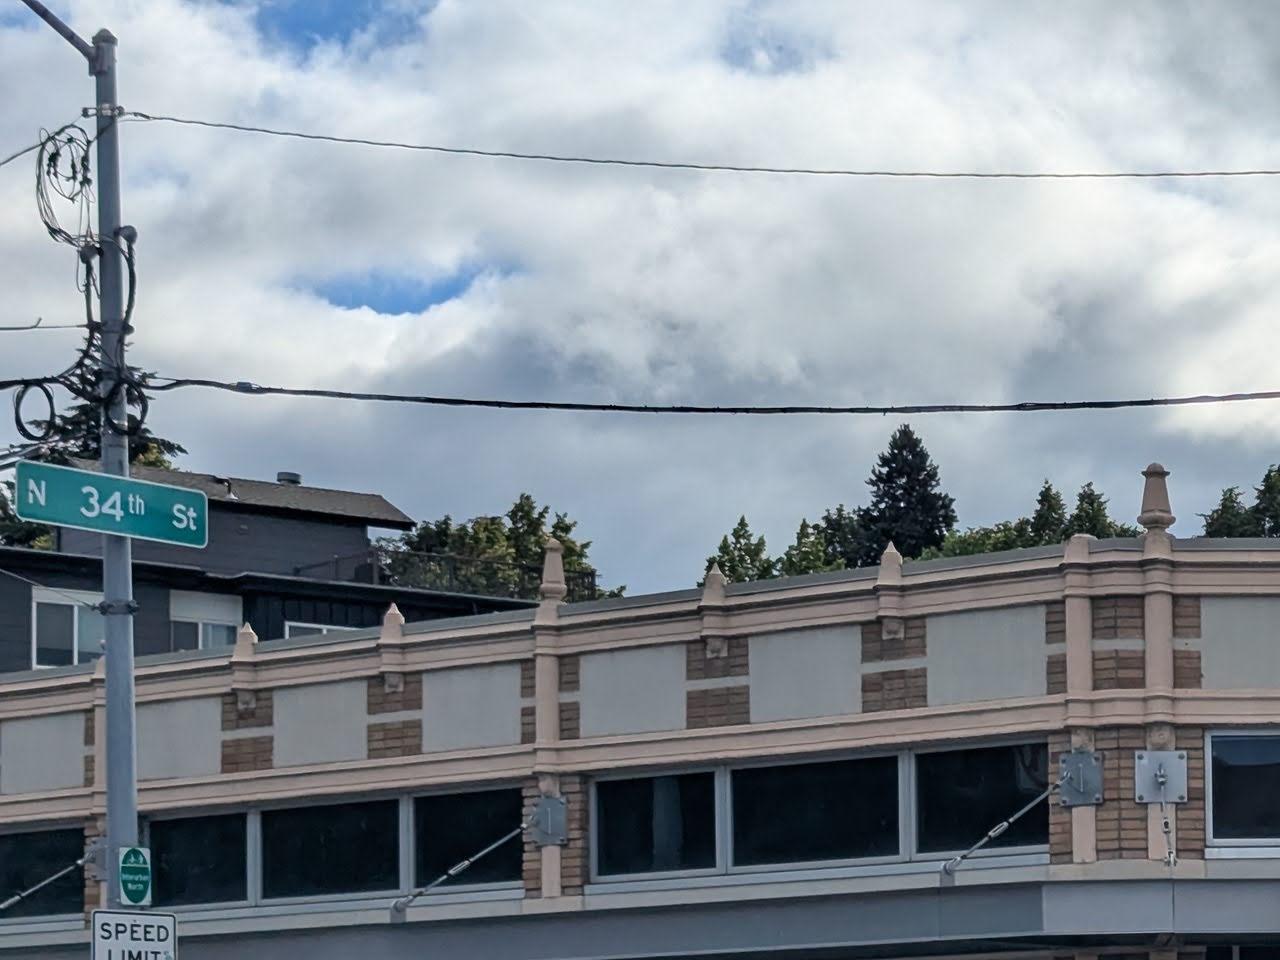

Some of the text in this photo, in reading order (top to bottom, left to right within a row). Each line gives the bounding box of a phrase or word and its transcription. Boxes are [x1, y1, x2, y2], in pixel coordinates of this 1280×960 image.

[28, 479, 197, 531] N 34th St
[100, 922, 169, 942] SPEED
